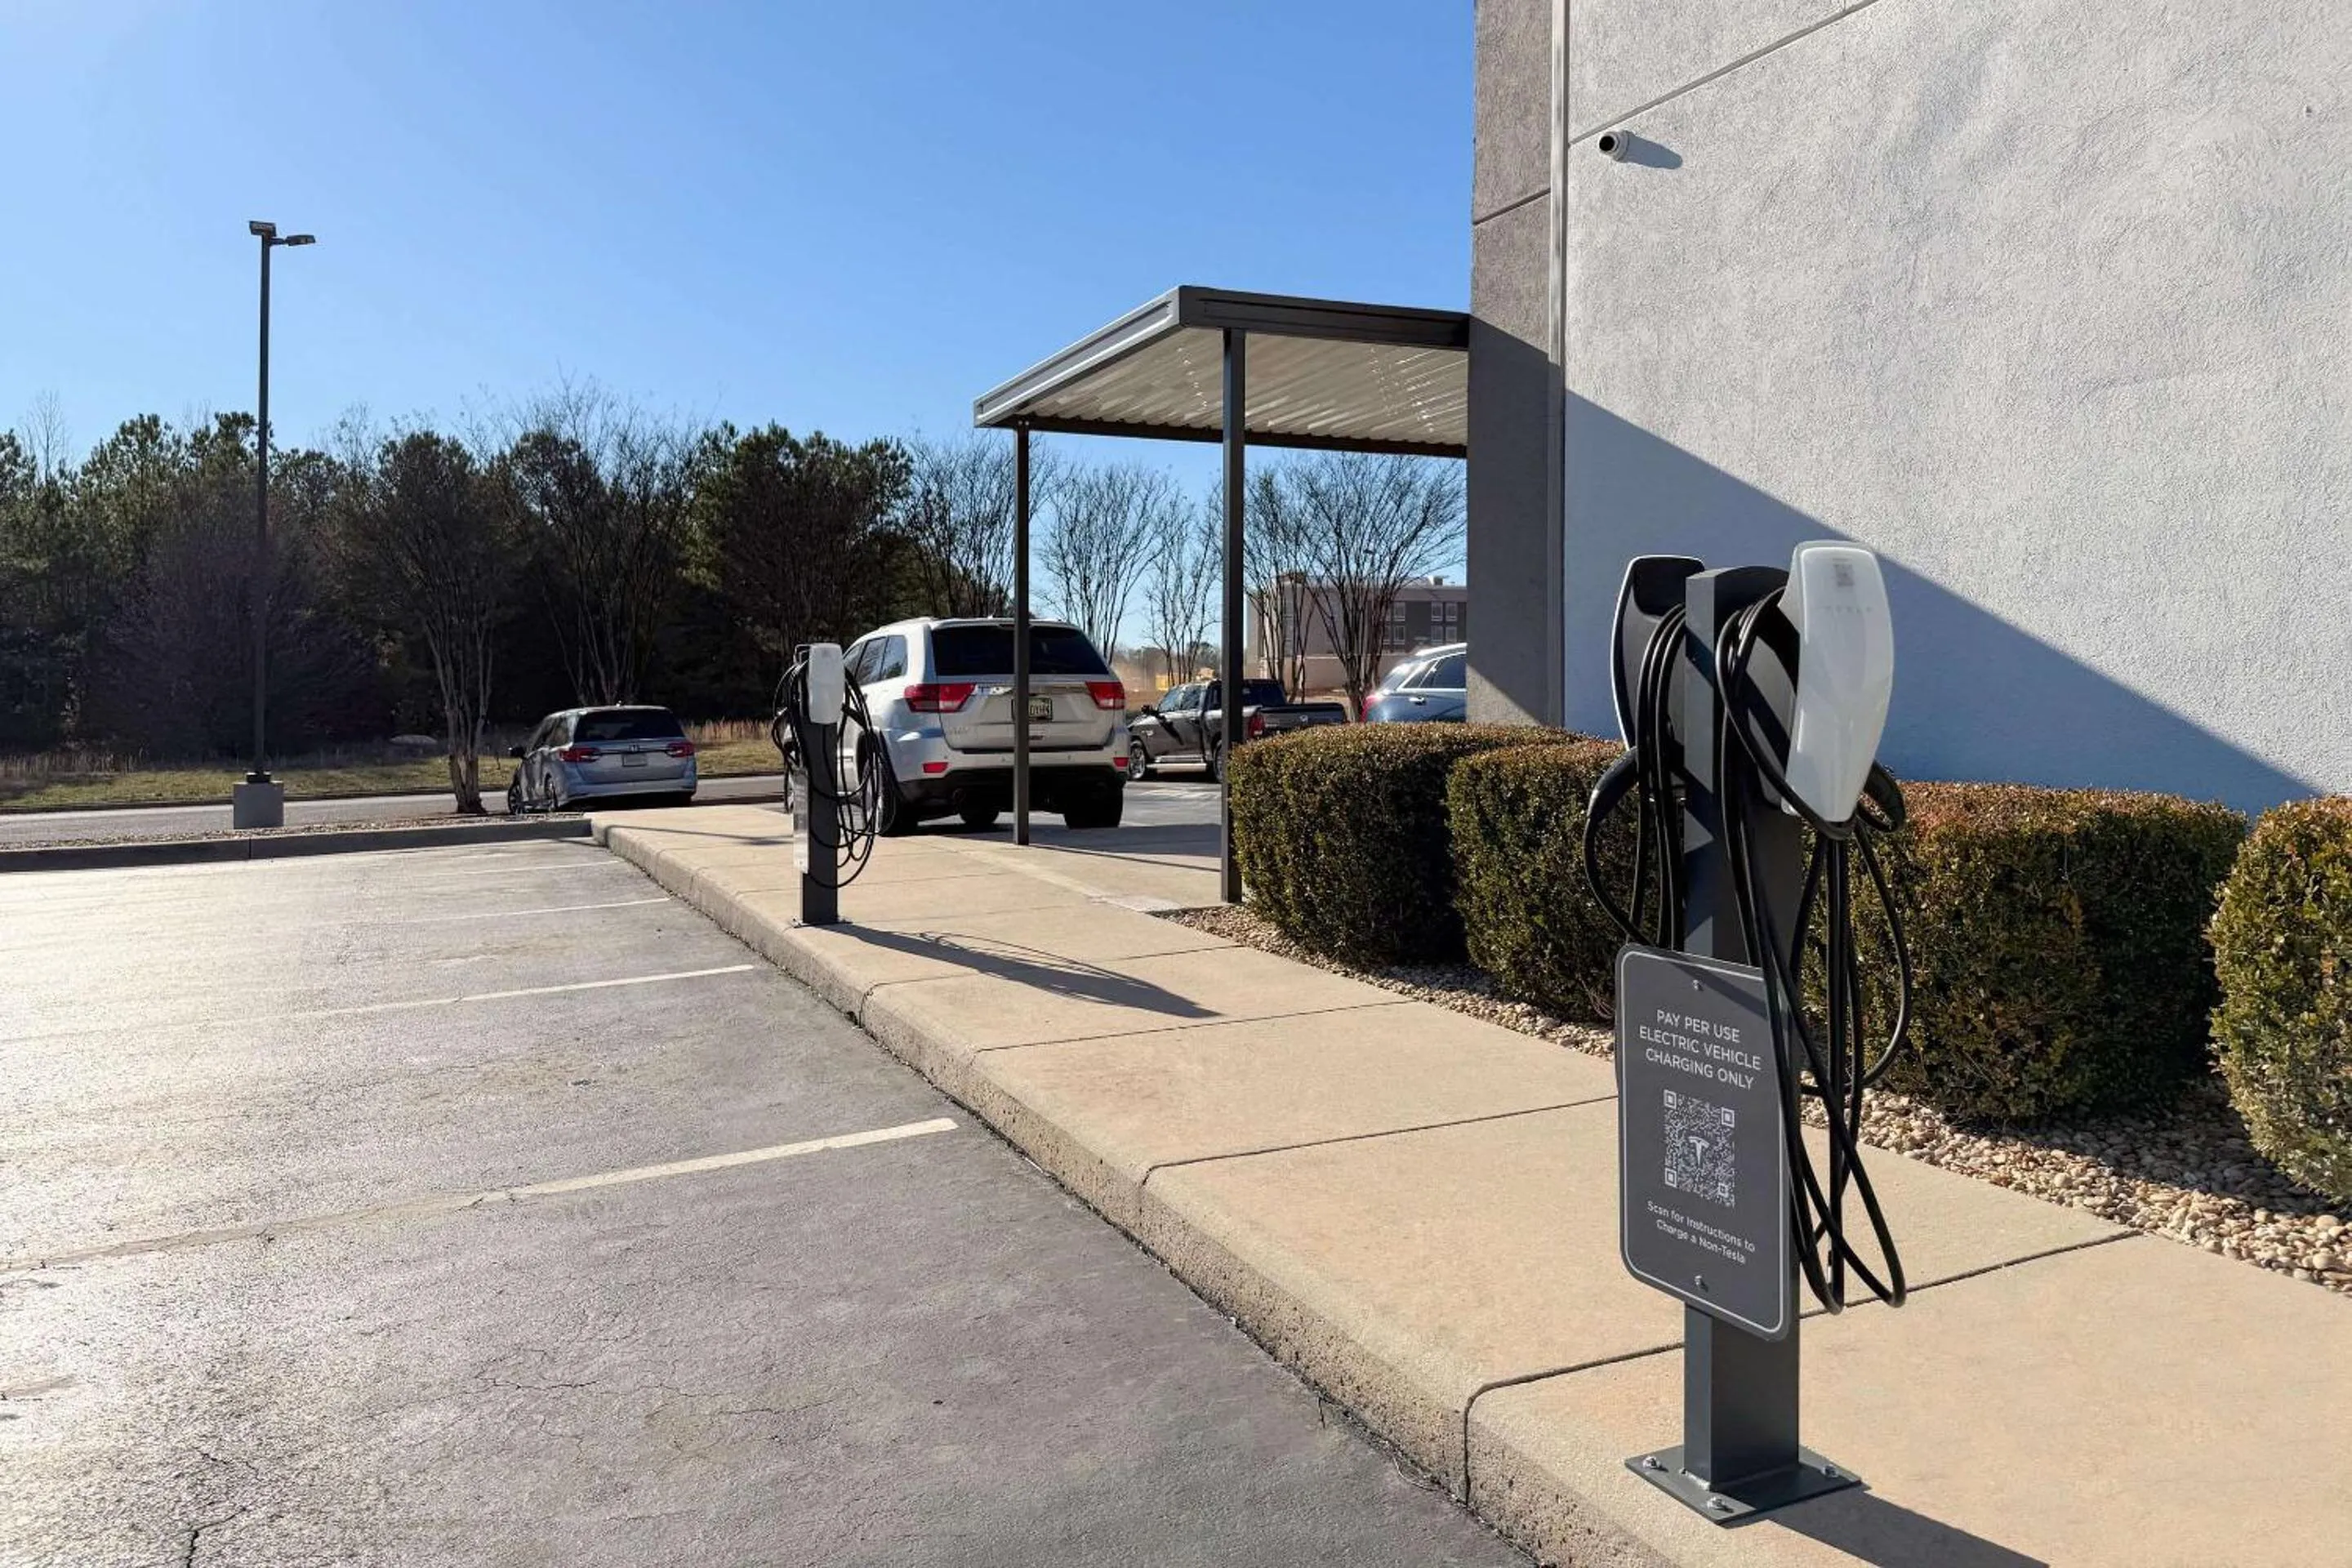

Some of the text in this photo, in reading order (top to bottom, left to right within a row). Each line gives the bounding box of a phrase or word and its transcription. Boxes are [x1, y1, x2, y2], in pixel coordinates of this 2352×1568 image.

[1639, 1025, 1762, 1071] ELECTRIC VEHICLE
[1657, 1009, 1740, 1043] PAY PER USE
[1646, 1048, 1754, 1090] CHARGING ONLY
[1647, 1200, 1755, 1253] Scan for Instructions to
[1656, 1218, 1746, 1264] Charge a Non-Tesla
